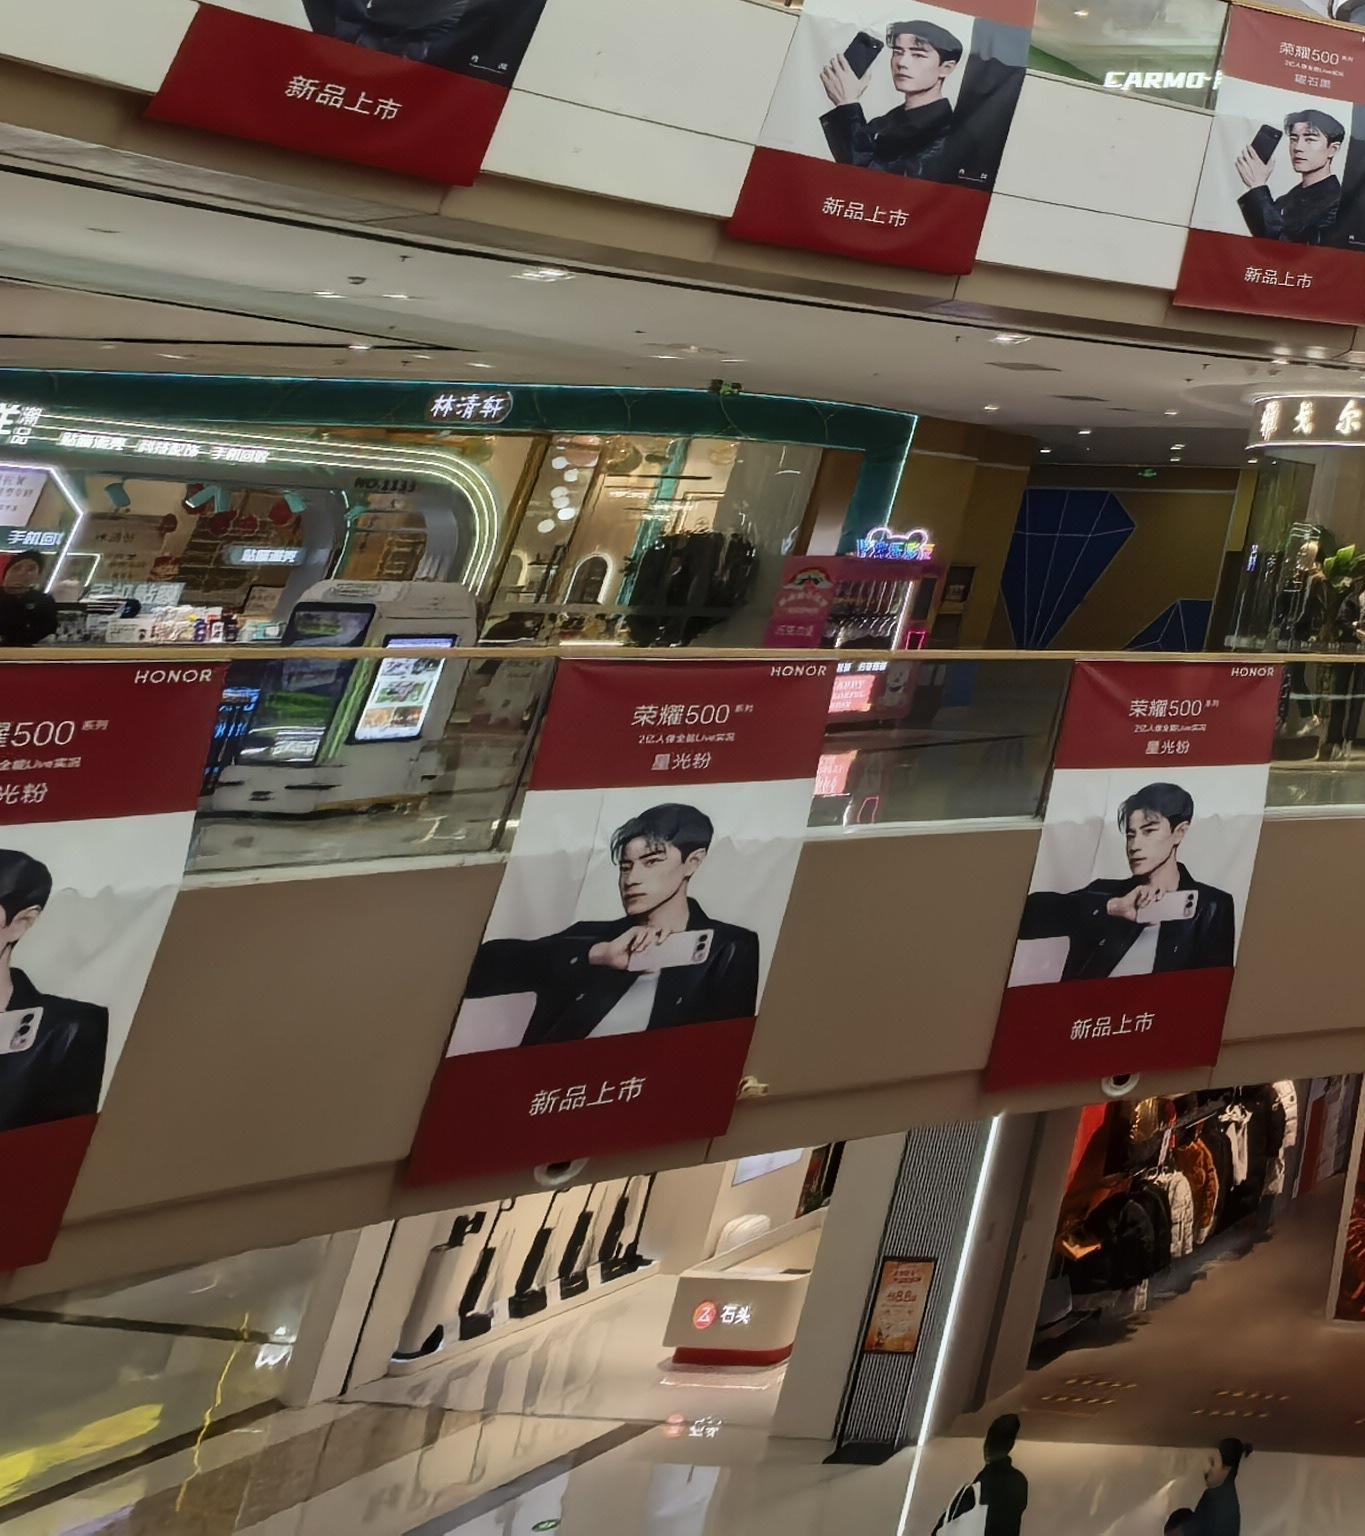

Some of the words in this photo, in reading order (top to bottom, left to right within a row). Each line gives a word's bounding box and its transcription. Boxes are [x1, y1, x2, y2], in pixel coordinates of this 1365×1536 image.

[1279, 41, 1339, 66] 荣耀500
[285, 75, 404, 121] 新品上市
[821, 195, 910, 230] 新品上市
[1244, 265, 1313, 290] 新品上市
[430, 392, 505, 421] 林清轩
[134, 668, 213, 685] HONOR
[770, 665, 828, 677] HONOR
[1230, 666, 1275, 678] HONOR
[631, 704, 729, 727] 荣耀500
[1128, 699, 1202, 718] 荣耀500
[1145, 740, 1190, 755] 星光粉
[651, 752, 712, 771] 星光粉
[0, 783, 48, 804] 光粉
[1070, 1011, 1156, 1041] 新品上市
[528, 1076, 647, 1118] 新品上市
[719, 1303, 751, 1326] 石头
